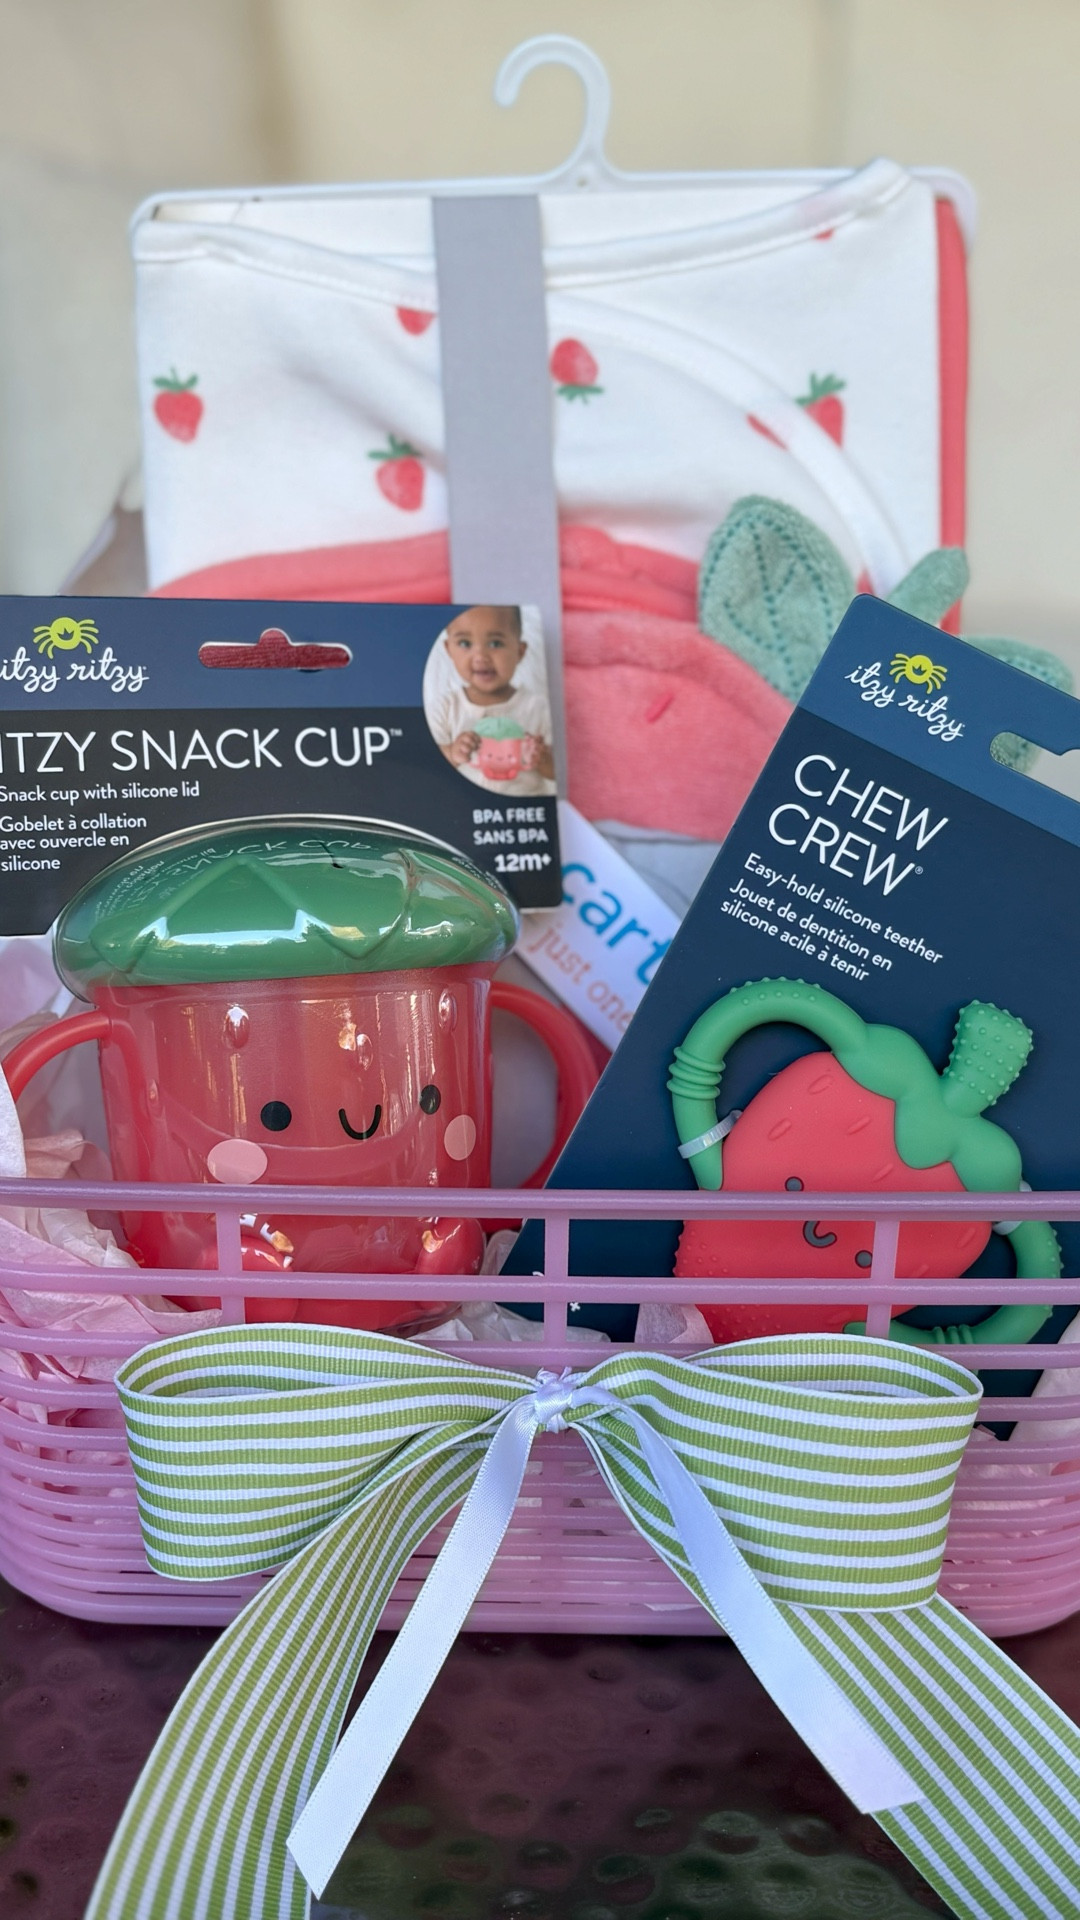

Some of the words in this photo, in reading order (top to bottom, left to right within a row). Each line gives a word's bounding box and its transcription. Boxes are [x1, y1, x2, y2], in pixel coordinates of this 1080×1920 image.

[0, 646, 60, 693] itzy
[844, 661, 896, 708] itzy
[898, 695, 966, 742] ritzy
[110, 728, 283, 772] SNACK
[0, 784, 47, 802] Snack
[50, 788, 80, 806] cup
[83, 783, 117, 801] with
[121, 782, 179, 799] silicone
[181, 781, 200, 797] lid
[794, 754, 949, 851] CHEW
[0, 814, 64, 833] Gobelet
[68, 814, 78, 831] à
[81, 812, 148, 831] collation
[472, 808, 503, 825] BPA
[506, 807, 546, 824] FREE
[473, 829, 515, 845] SANS
[517, 828, 549, 844] BPA
[0, 837, 36, 850] avec
[39, 832, 107, 849] ouvercle
[110, 834, 130, 847] en
[1, 854, 61, 872] silicone
[494, 852, 552, 873] 12m+
[729, 878, 776, 907] Jouet
[777, 902, 797, 923] de
[799, 914, 870, 960] dentition
[872, 953, 893, 971] en
[743, 852, 825, 904] Easy-hold
[823, 896, 882, 934] silicone
[883, 925, 944, 964] teether
[527, 921, 592, 984] just
[720, 899, 779, 937] silicone
[780, 934, 816, 956] acile
[817, 944, 831, 962] à
[830, 954, 869, 982] tenir
